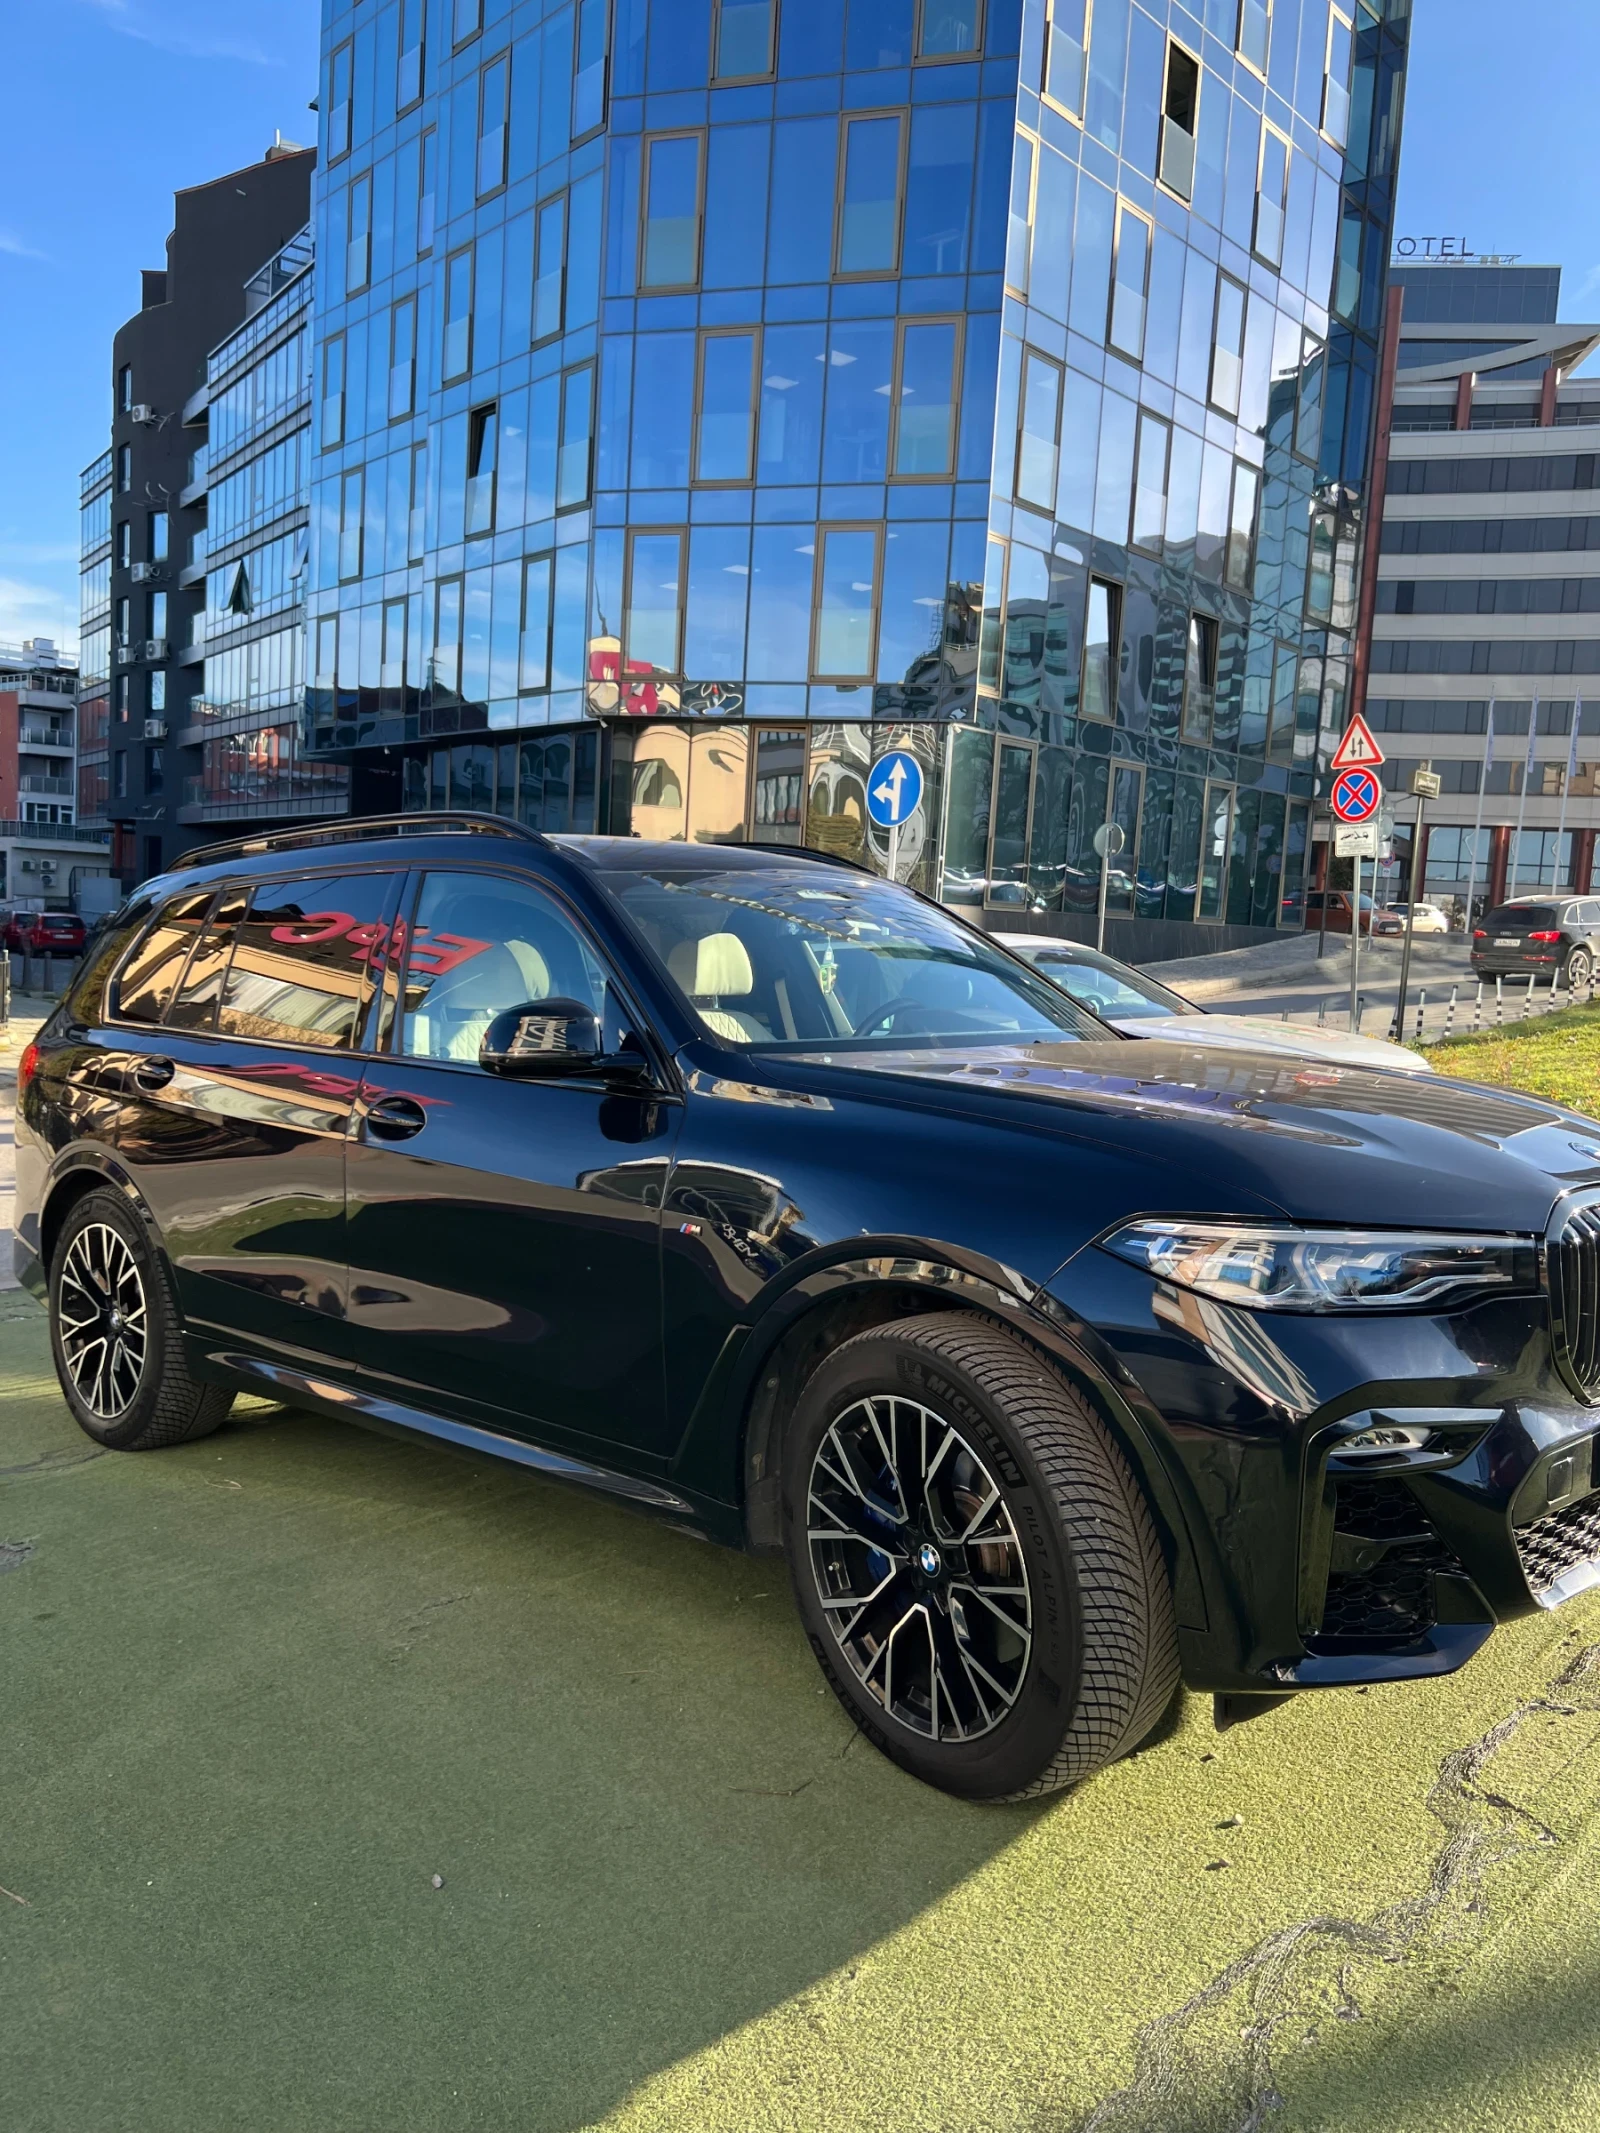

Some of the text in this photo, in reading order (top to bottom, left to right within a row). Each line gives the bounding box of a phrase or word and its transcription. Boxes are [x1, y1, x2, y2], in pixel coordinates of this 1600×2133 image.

[1397, 237, 1474, 256] OTEL
[926, 1374, 1021, 1482] MICHELIN
[1022, 1506, 1048, 1560] PILOT
[1039, 1568, 1059, 1627] ALPIN
